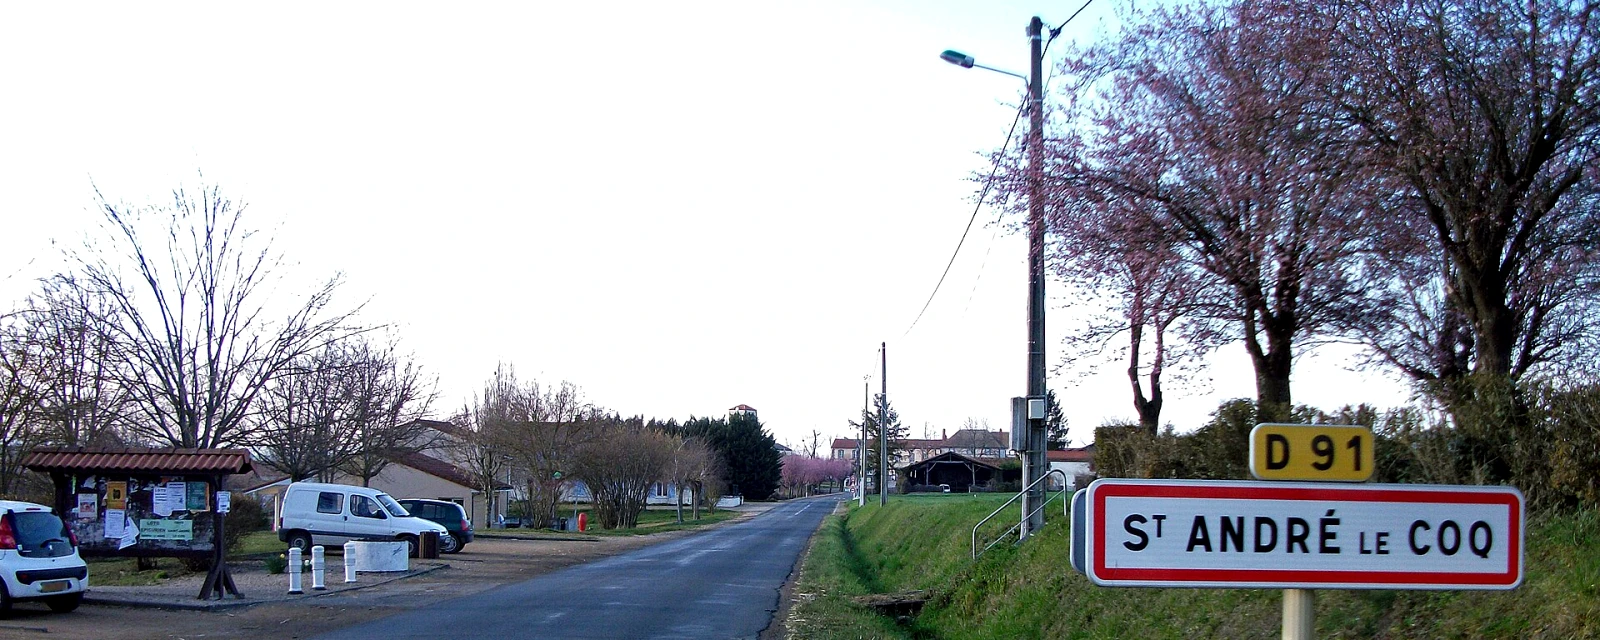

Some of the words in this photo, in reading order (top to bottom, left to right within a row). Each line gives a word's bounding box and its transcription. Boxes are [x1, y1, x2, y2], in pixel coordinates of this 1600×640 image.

[1265, 433, 1291, 472] D
[1310, 433, 1362, 472] 91
[1185, 508, 1341, 554] ANDRÉ
[1359, 531, 1390, 555] LE
[1408, 519, 1493, 559] COQ
